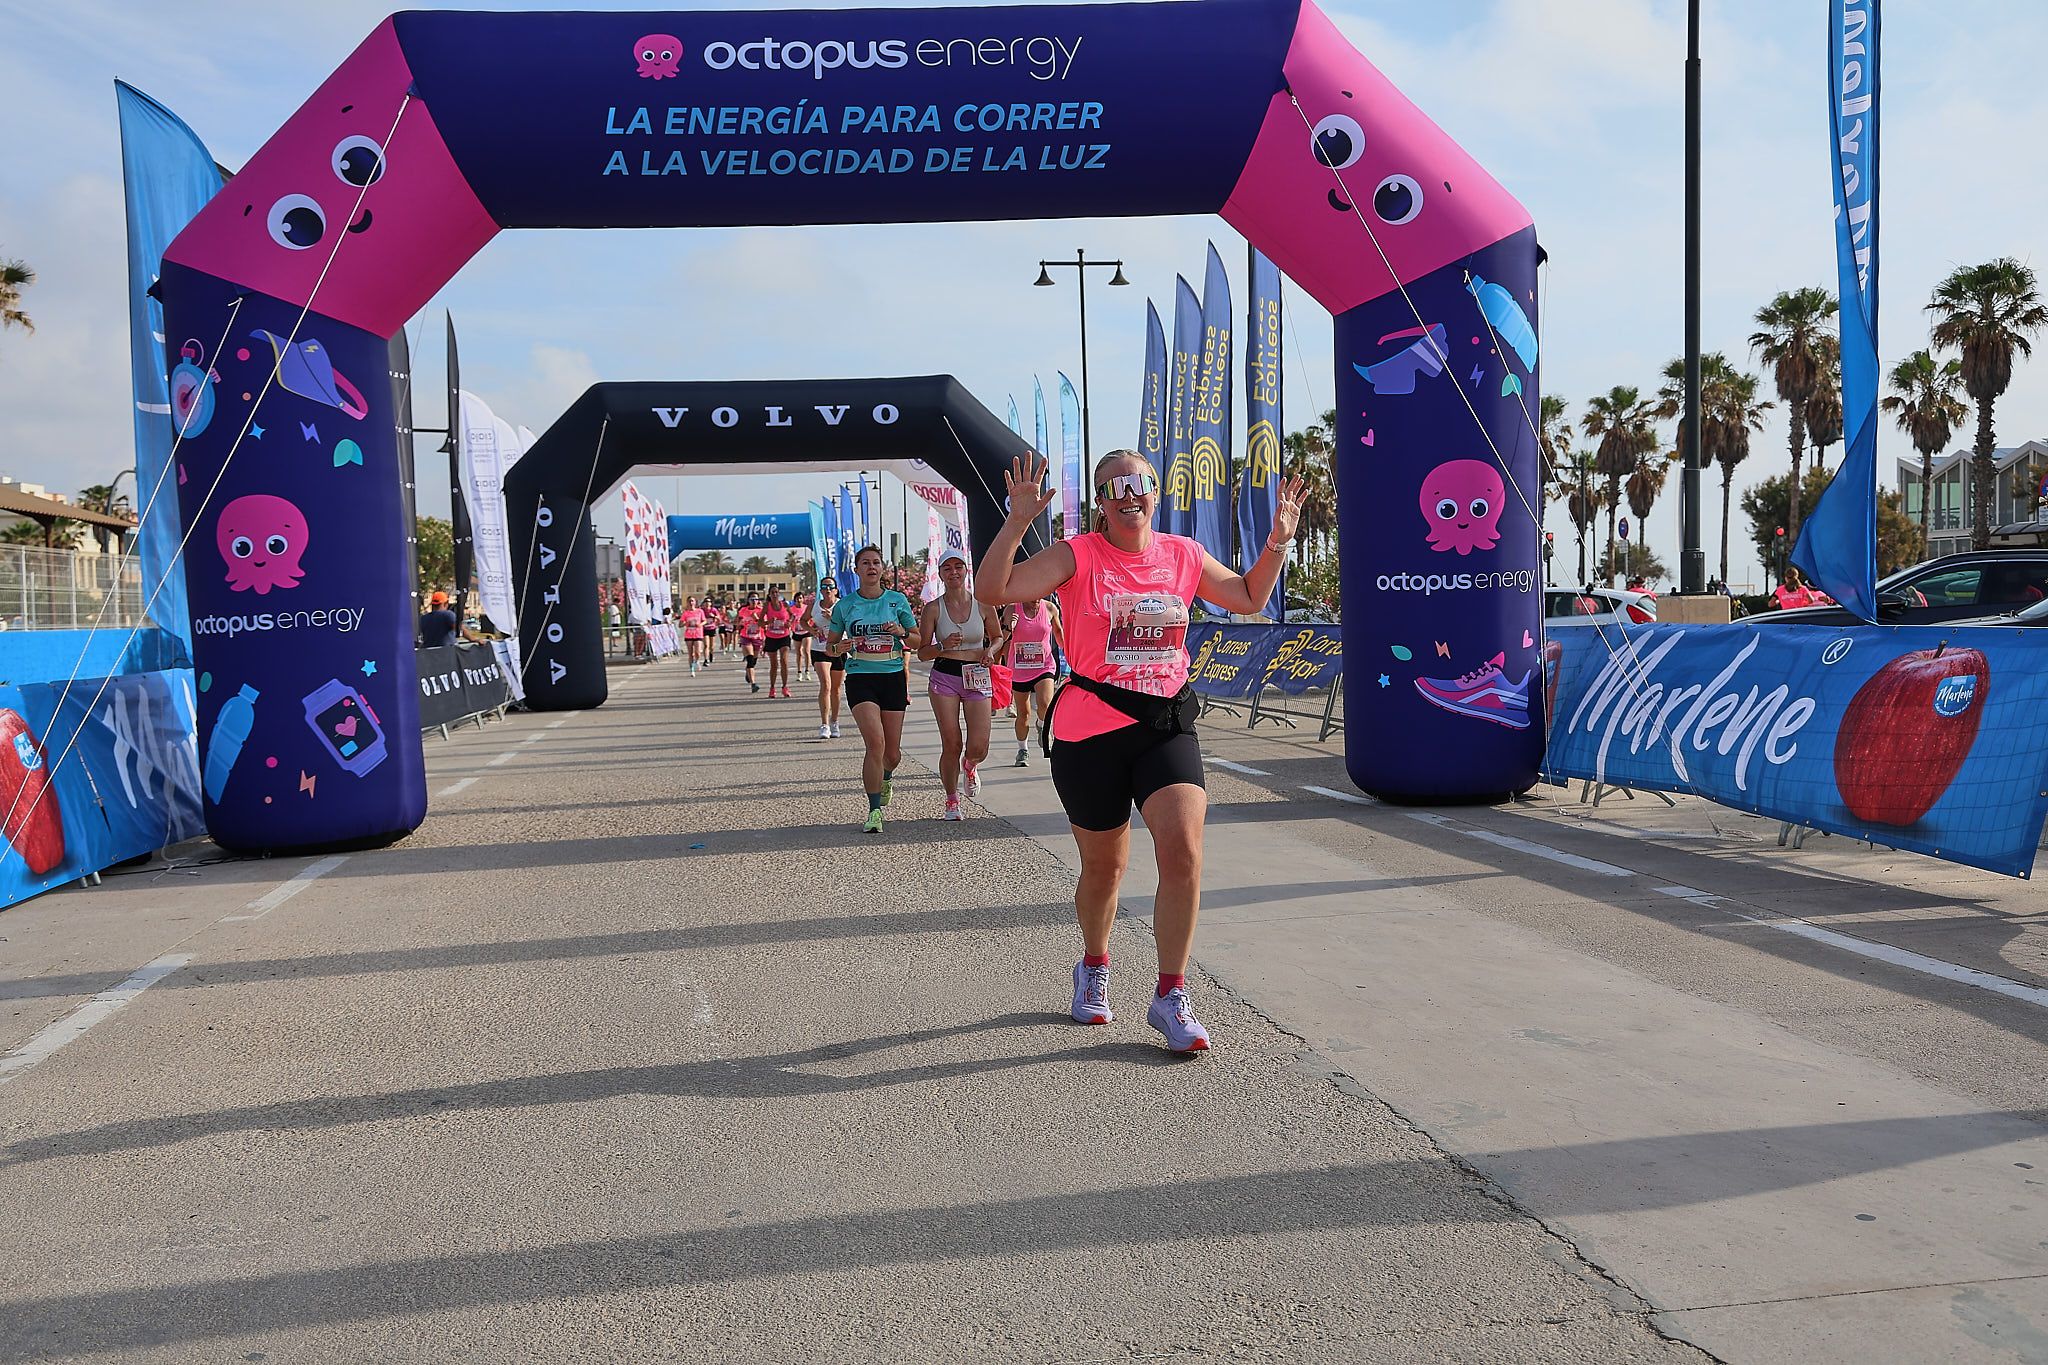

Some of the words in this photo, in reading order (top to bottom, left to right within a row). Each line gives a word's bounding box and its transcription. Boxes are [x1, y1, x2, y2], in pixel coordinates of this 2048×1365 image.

[703, 36, 909, 80] octopus
[916, 36, 1083, 81] energy
[605, 107, 653, 135] LA
[664, 99, 829, 135] ENERGÍA
[840, 105, 942, 134] PARA
[953, 101, 1104, 131] CORRER
[603, 150, 630, 177] A
[640, 150, 688, 176] LA
[700, 147, 914, 175] VELOCIDAD
[923, 146, 974, 173] DE
[982, 145, 1028, 172] LA
[1037, 143, 1112, 171] LUZ
[651, 403, 900, 429] VOLVO
[715, 518, 777, 545] Marlene
[537, 507, 567, 685] VOLVO
[1376, 572, 1472, 596] octopus
[1475, 570, 1535, 593] energy
[194, 609, 274, 639] octopus
[276, 607, 365, 633] energy
[1133, 626, 1164, 638] 016
[1217, 640, 1252, 656] Correos
[420, 670, 461, 697] OLVO
[464, 663, 500, 687] VOLVO
[1203, 658, 1240, 684] Express
[1568, 629, 1816, 792] Marlene
[1937, 685, 1973, 708] Marlene
